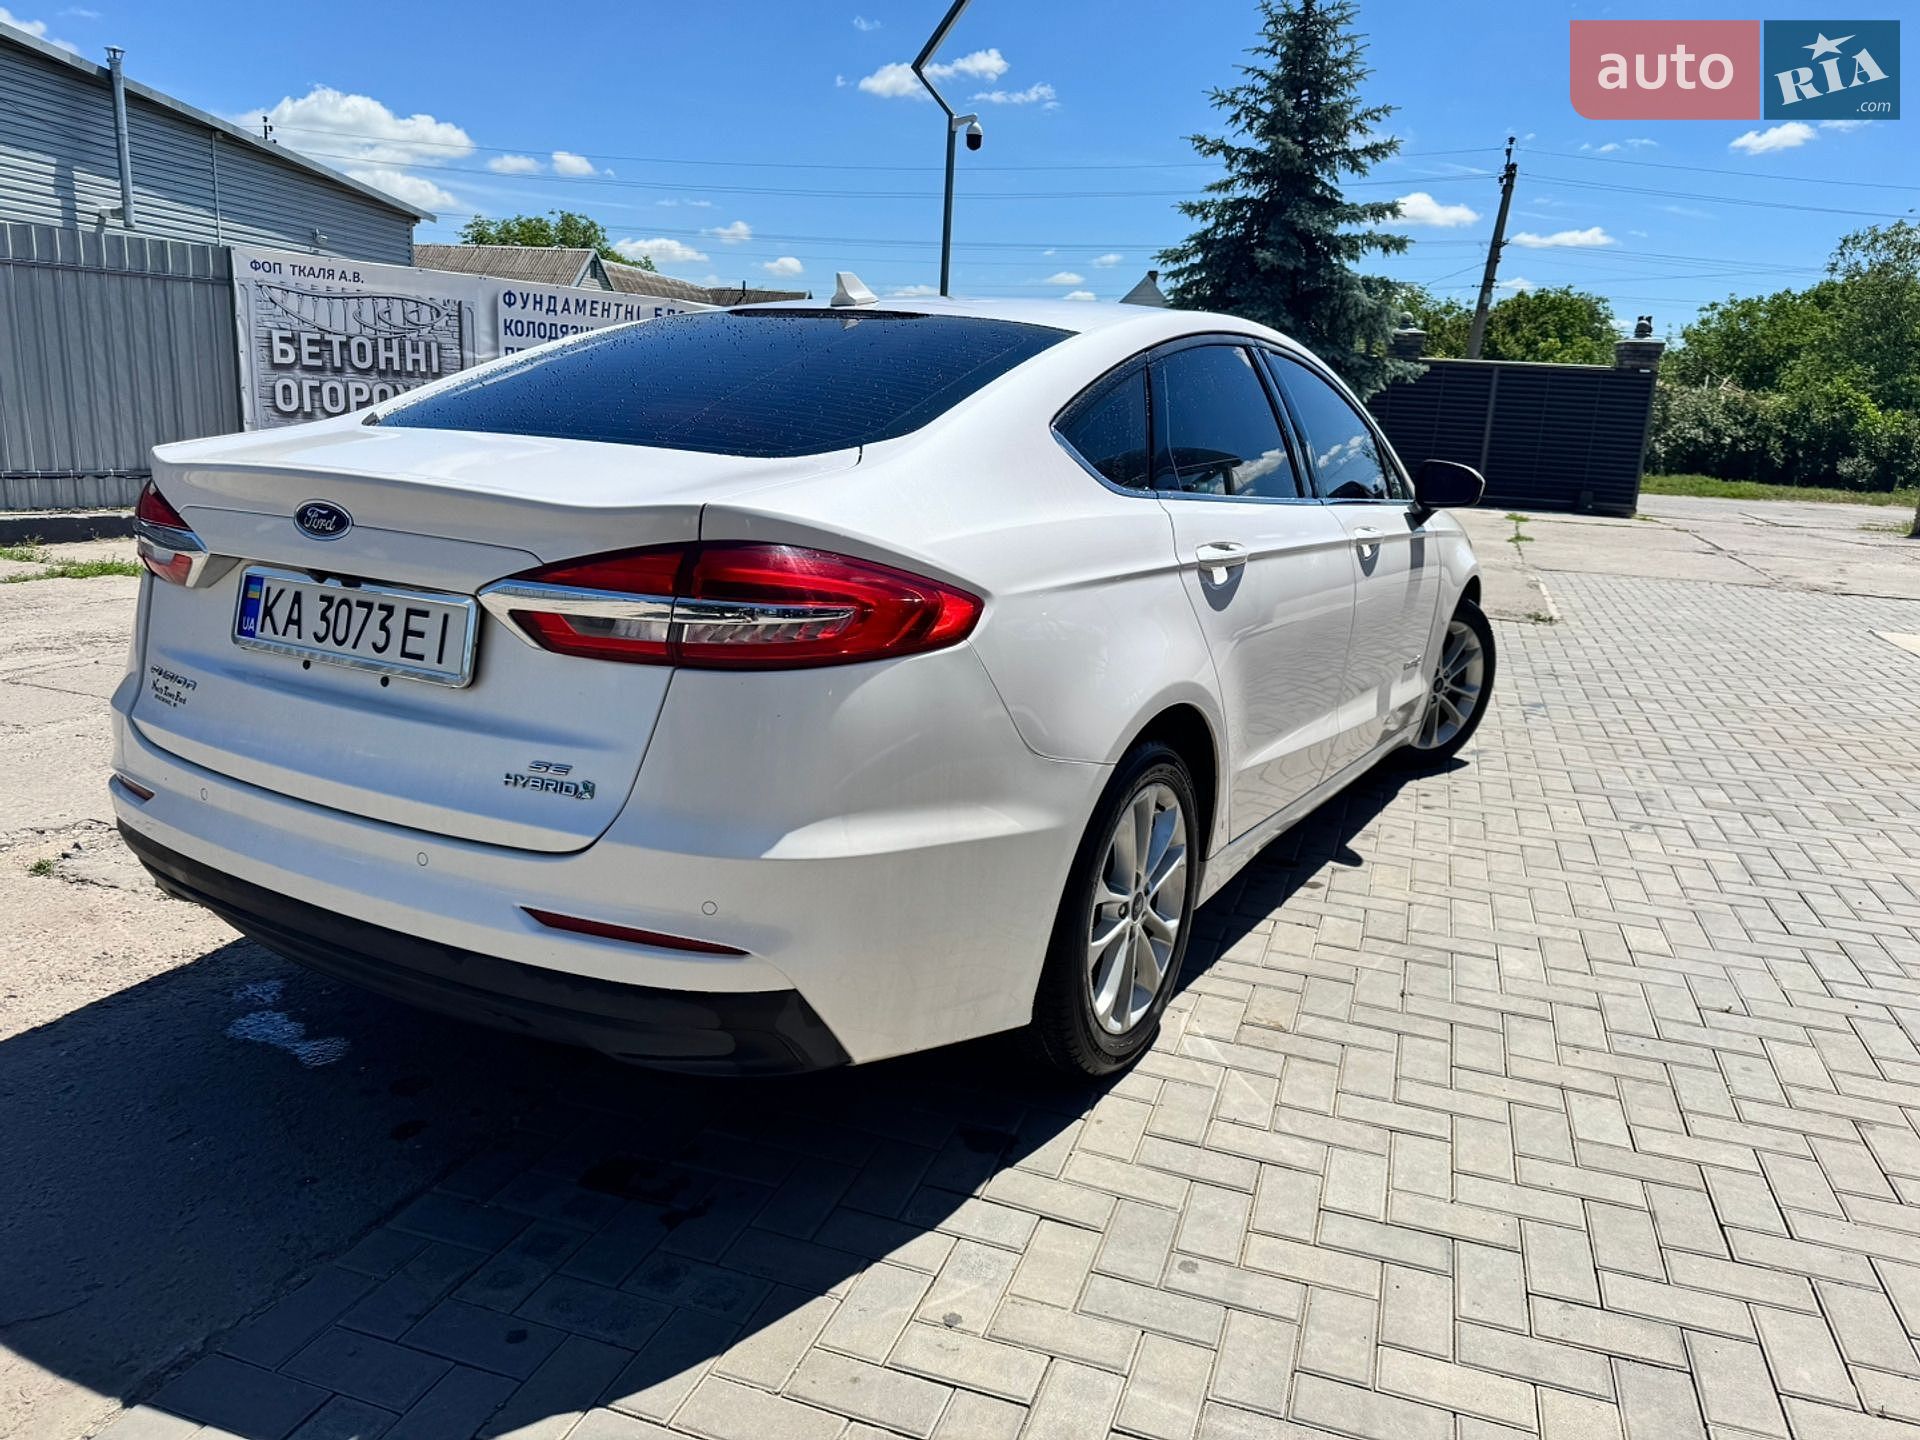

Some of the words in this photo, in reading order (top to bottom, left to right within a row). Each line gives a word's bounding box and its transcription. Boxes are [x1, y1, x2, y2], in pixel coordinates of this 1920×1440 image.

[250, 259, 282, 275] ФОП
[289, 264, 335, 281] ТКАЛЯ
[339, 270, 364, 284] А.В.
[503, 290, 641, 321] ФУНДАМЕНТНІ
[270, 329, 440, 373] БЕТОННІ
[304, 507, 337, 531] Ford
[242, 616, 255, 632] UA
[260, 586, 303, 639] KA
[313, 594, 395, 654] 3073
[528, 760, 573, 776] SE
[504, 772, 579, 797] HYBRID
